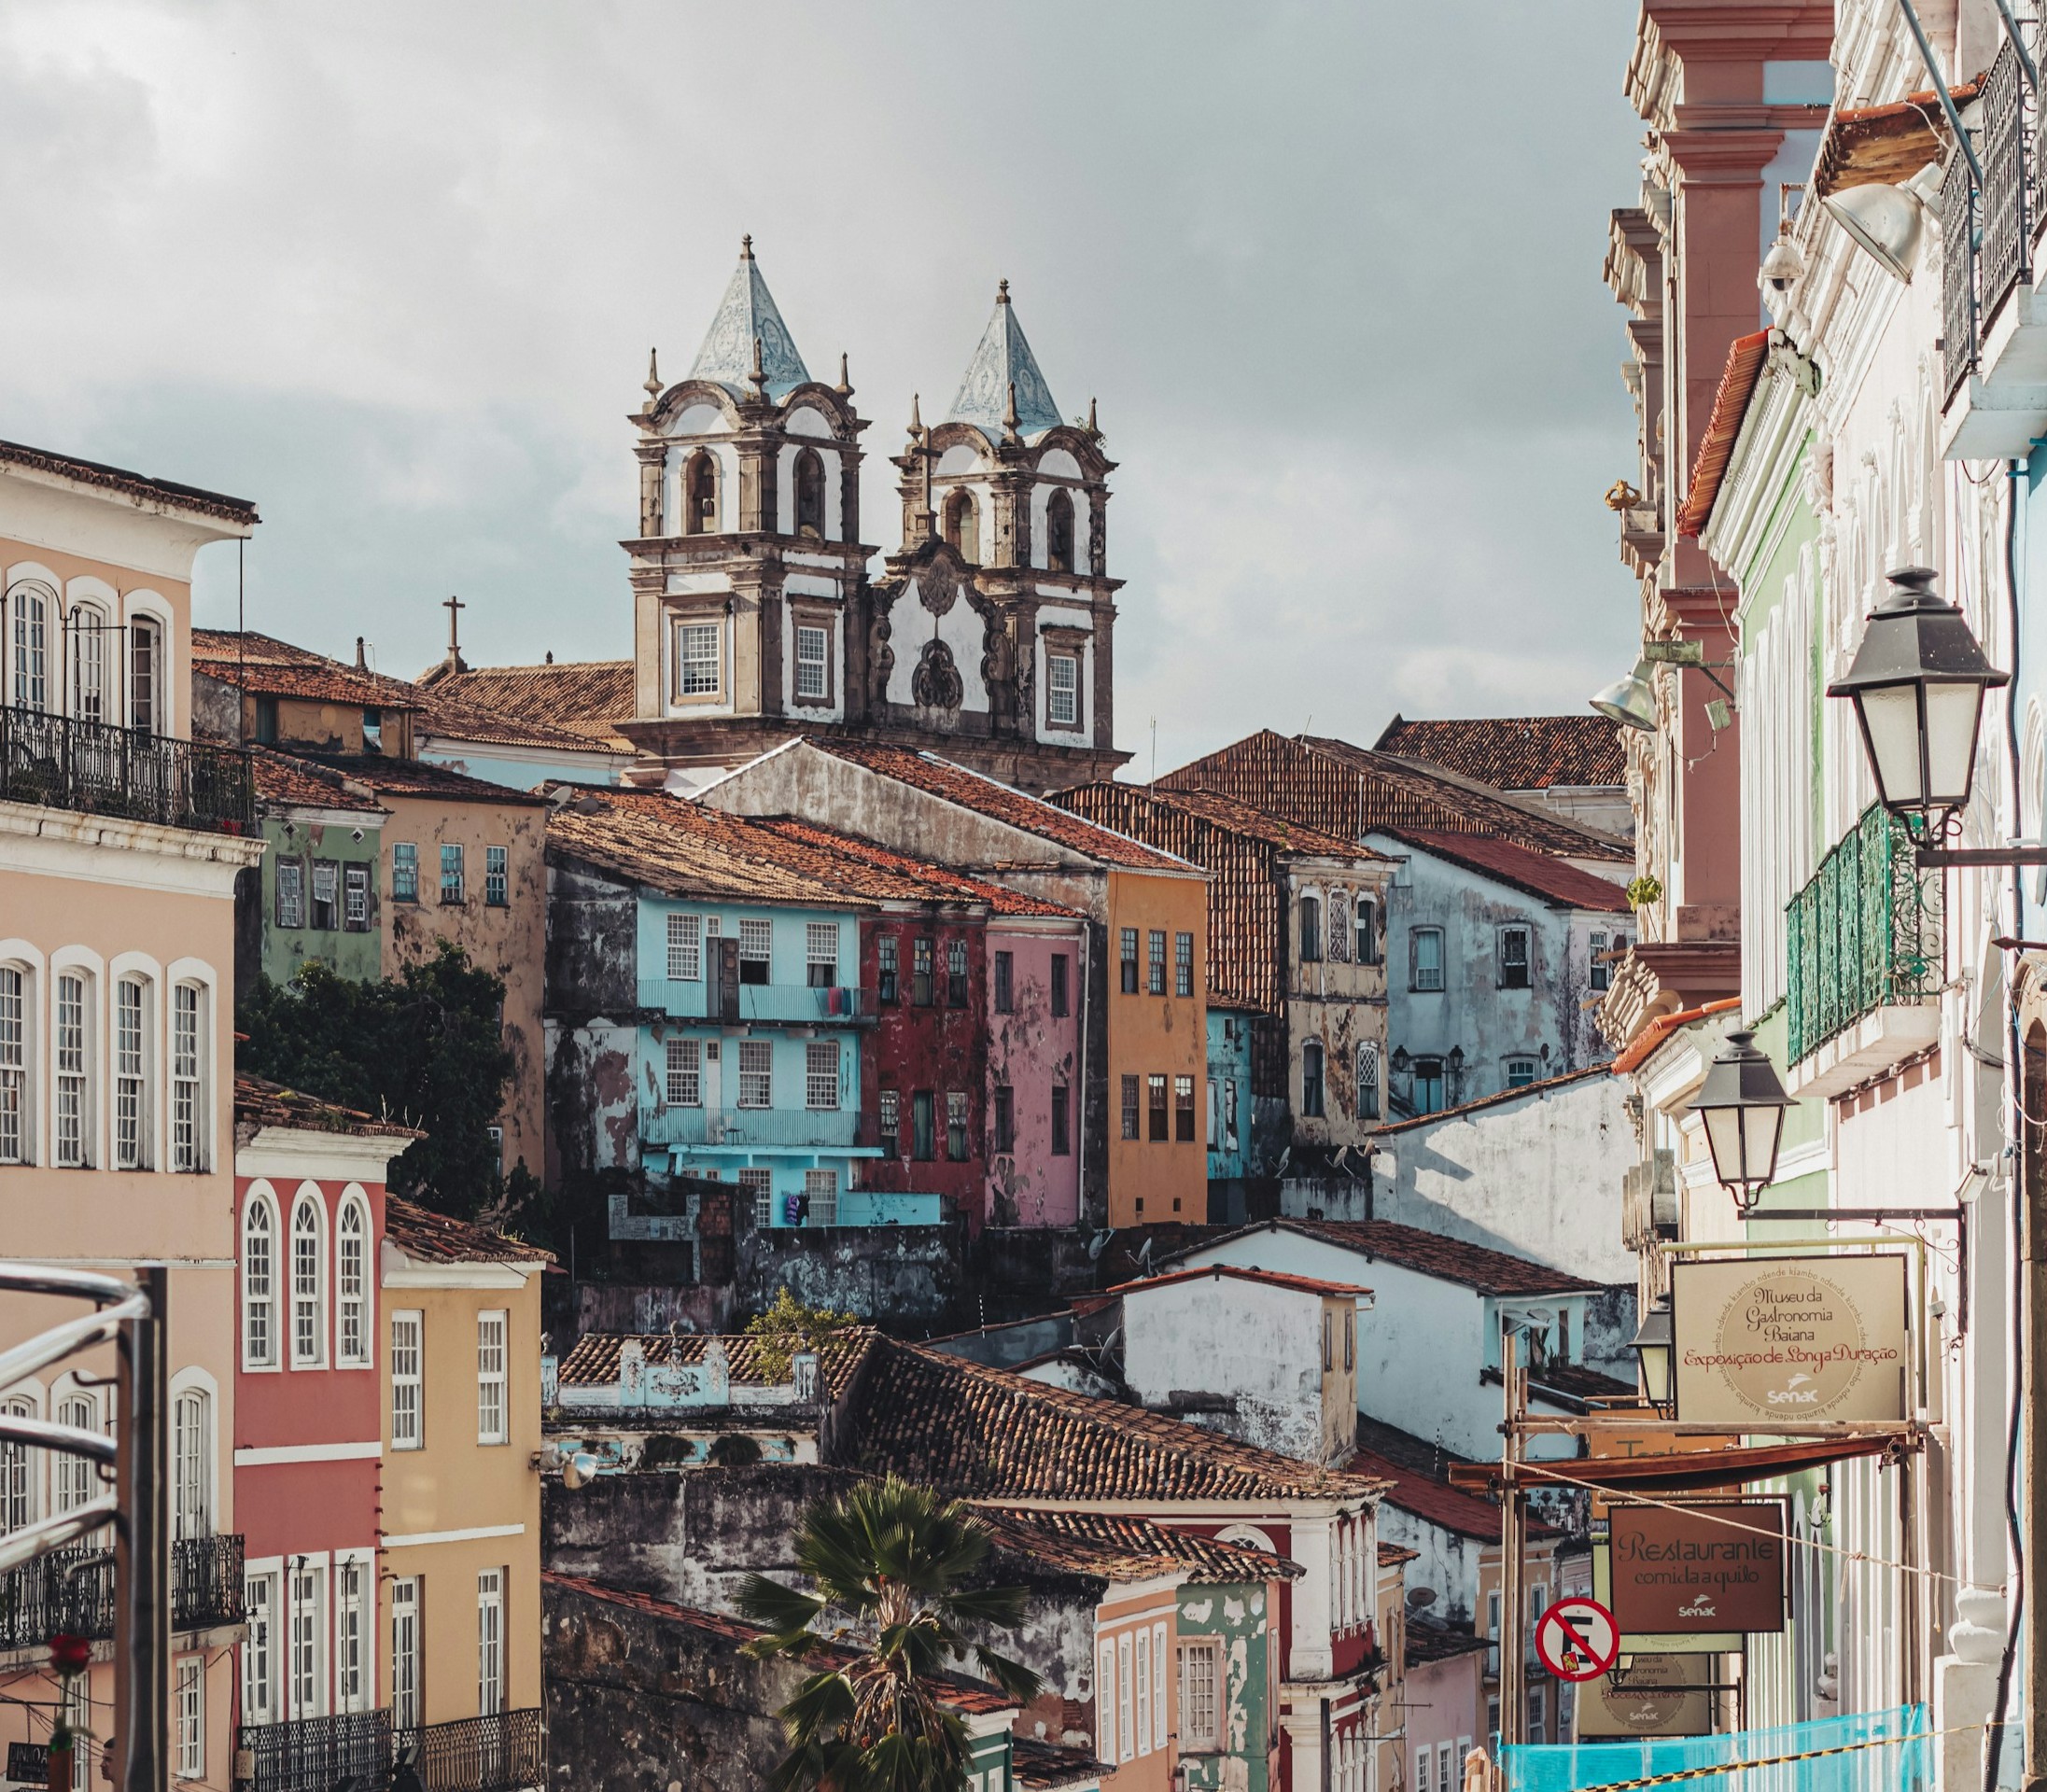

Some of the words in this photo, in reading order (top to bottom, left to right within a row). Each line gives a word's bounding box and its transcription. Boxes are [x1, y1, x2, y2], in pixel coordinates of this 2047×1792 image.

[1758, 1267, 1787, 1282] ndende
[1788, 1267, 1818, 1281] kiambo
[1730, 1280, 1756, 1302] kiambo
[1754, 1288, 1804, 1305] Museu
[1806, 1285, 1822, 1303] da
[1820, 1277, 1845, 1297] ndende
[1718, 1302, 1733, 1330] ndende
[1746, 1306, 1833, 1332] Gastronomia
[1845, 1295, 1862, 1324] kiambo
[1764, 1325, 1815, 1342] Baiana
[1684, 1349, 1762, 1373] Exposição
[1763, 1346, 1784, 1363] de
[1785, 1345, 1831, 1374] Longa
[1832, 1343, 1898, 1365] Duração
[1717, 1364, 1736, 1392] ndende
[1735, 1392, 1761, 1416] kiambo
[1827, 1388, 1851, 1411] ndende
[1764, 1410, 1794, 1422] ndende
[1797, 1407, 1827, 1421] kiambo
[1618, 1532, 1774, 1561] Restaurante
[1634, 1565, 1699, 1585] comida
[1702, 1571, 1712, 1584] a
[1714, 1564, 1760, 1593] quilo
[1563, 1616, 1592, 1664] E
